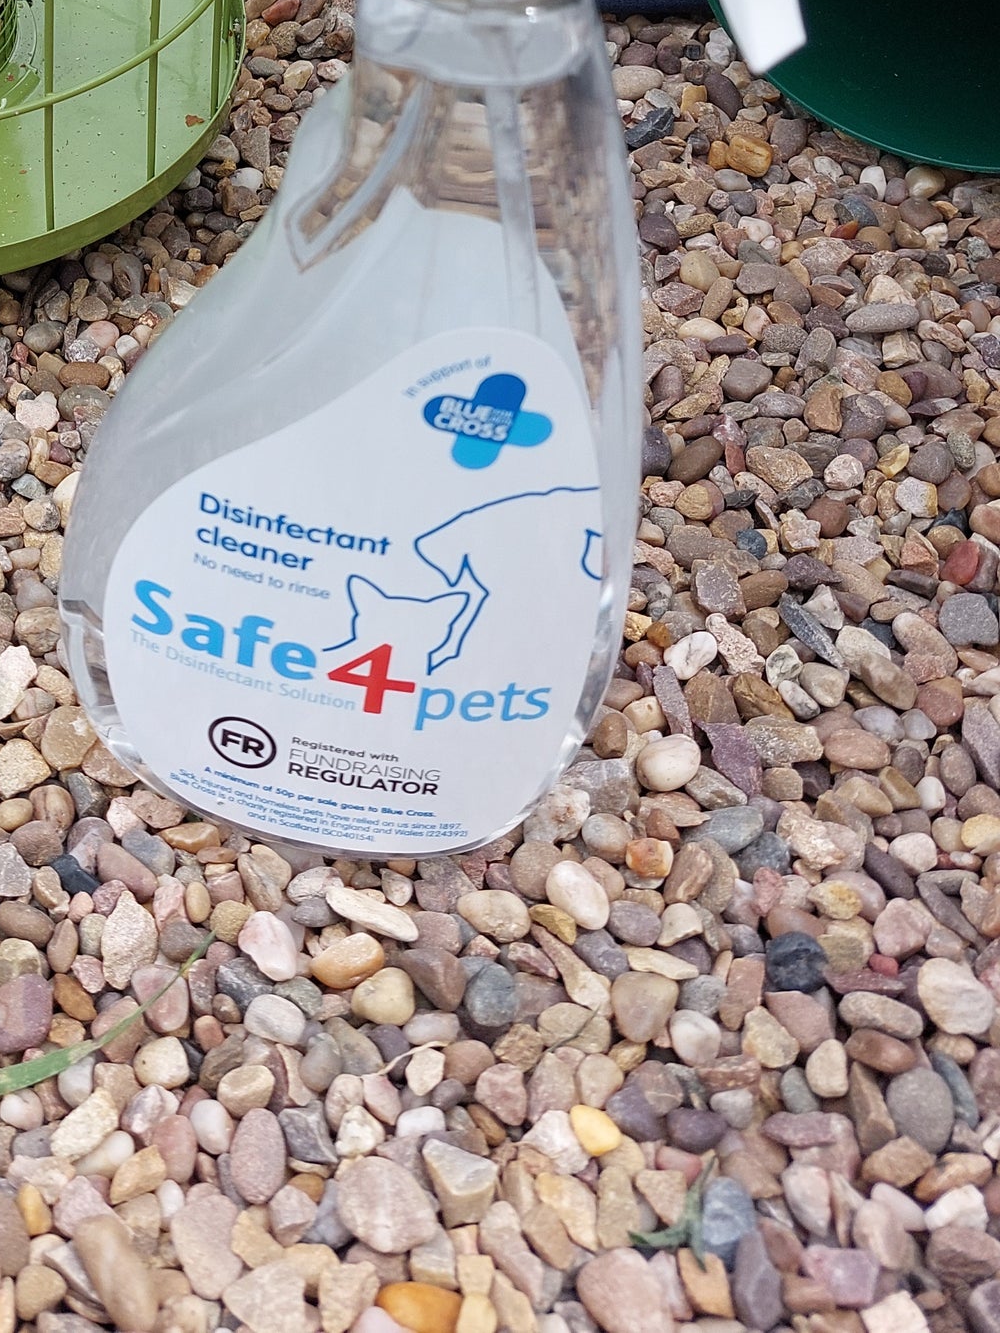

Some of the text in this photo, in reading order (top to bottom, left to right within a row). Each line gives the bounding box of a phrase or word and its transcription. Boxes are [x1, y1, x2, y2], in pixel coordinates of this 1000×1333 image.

[434, 413, 509, 441] CROSS
[439, 397, 494, 423] BLUE
[200, 492, 391, 555] Disinfectant
[197, 527, 313, 570] cleaner
[194, 553, 331, 599] No need to rinse
[130, 629, 356, 711] The Disinfectant Solution
[220, 728, 265, 758] FR
[292, 737, 399, 762] Registered with
[288, 762, 438, 795] REGULATOR
[289, 748, 441, 781] FUNDRAISING
[170, 773, 189, 785] Blue
[191, 782, 216, 795] Cross
[218, 791, 226, 799] is
[237, 798, 266, 813] charity
[270, 807, 317, 823] registered
[320, 817, 328, 825] in
[331, 820, 369, 833] England
[373, 826, 391, 834] and
[215, 770, 259, 788] minimum
[263, 784, 272, 792] of
[276, 788, 294, 798] 50p
[298, 794, 314, 802] per
[318, 797, 337, 807] sale
[341, 802, 364, 811] goes
[381, 807, 403, 815] Blue
[234, 789, 252, 800] and
[255, 795, 301, 812] homeless
[303, 807, 324, 817] pets
[326, 812, 349, 822] have
[352, 816, 379, 826] relied
[411, 822, 436, 830] since
[248, 811, 265, 821] and
[268, 814, 276, 823] in
[279, 818, 319, 833] Scotland
